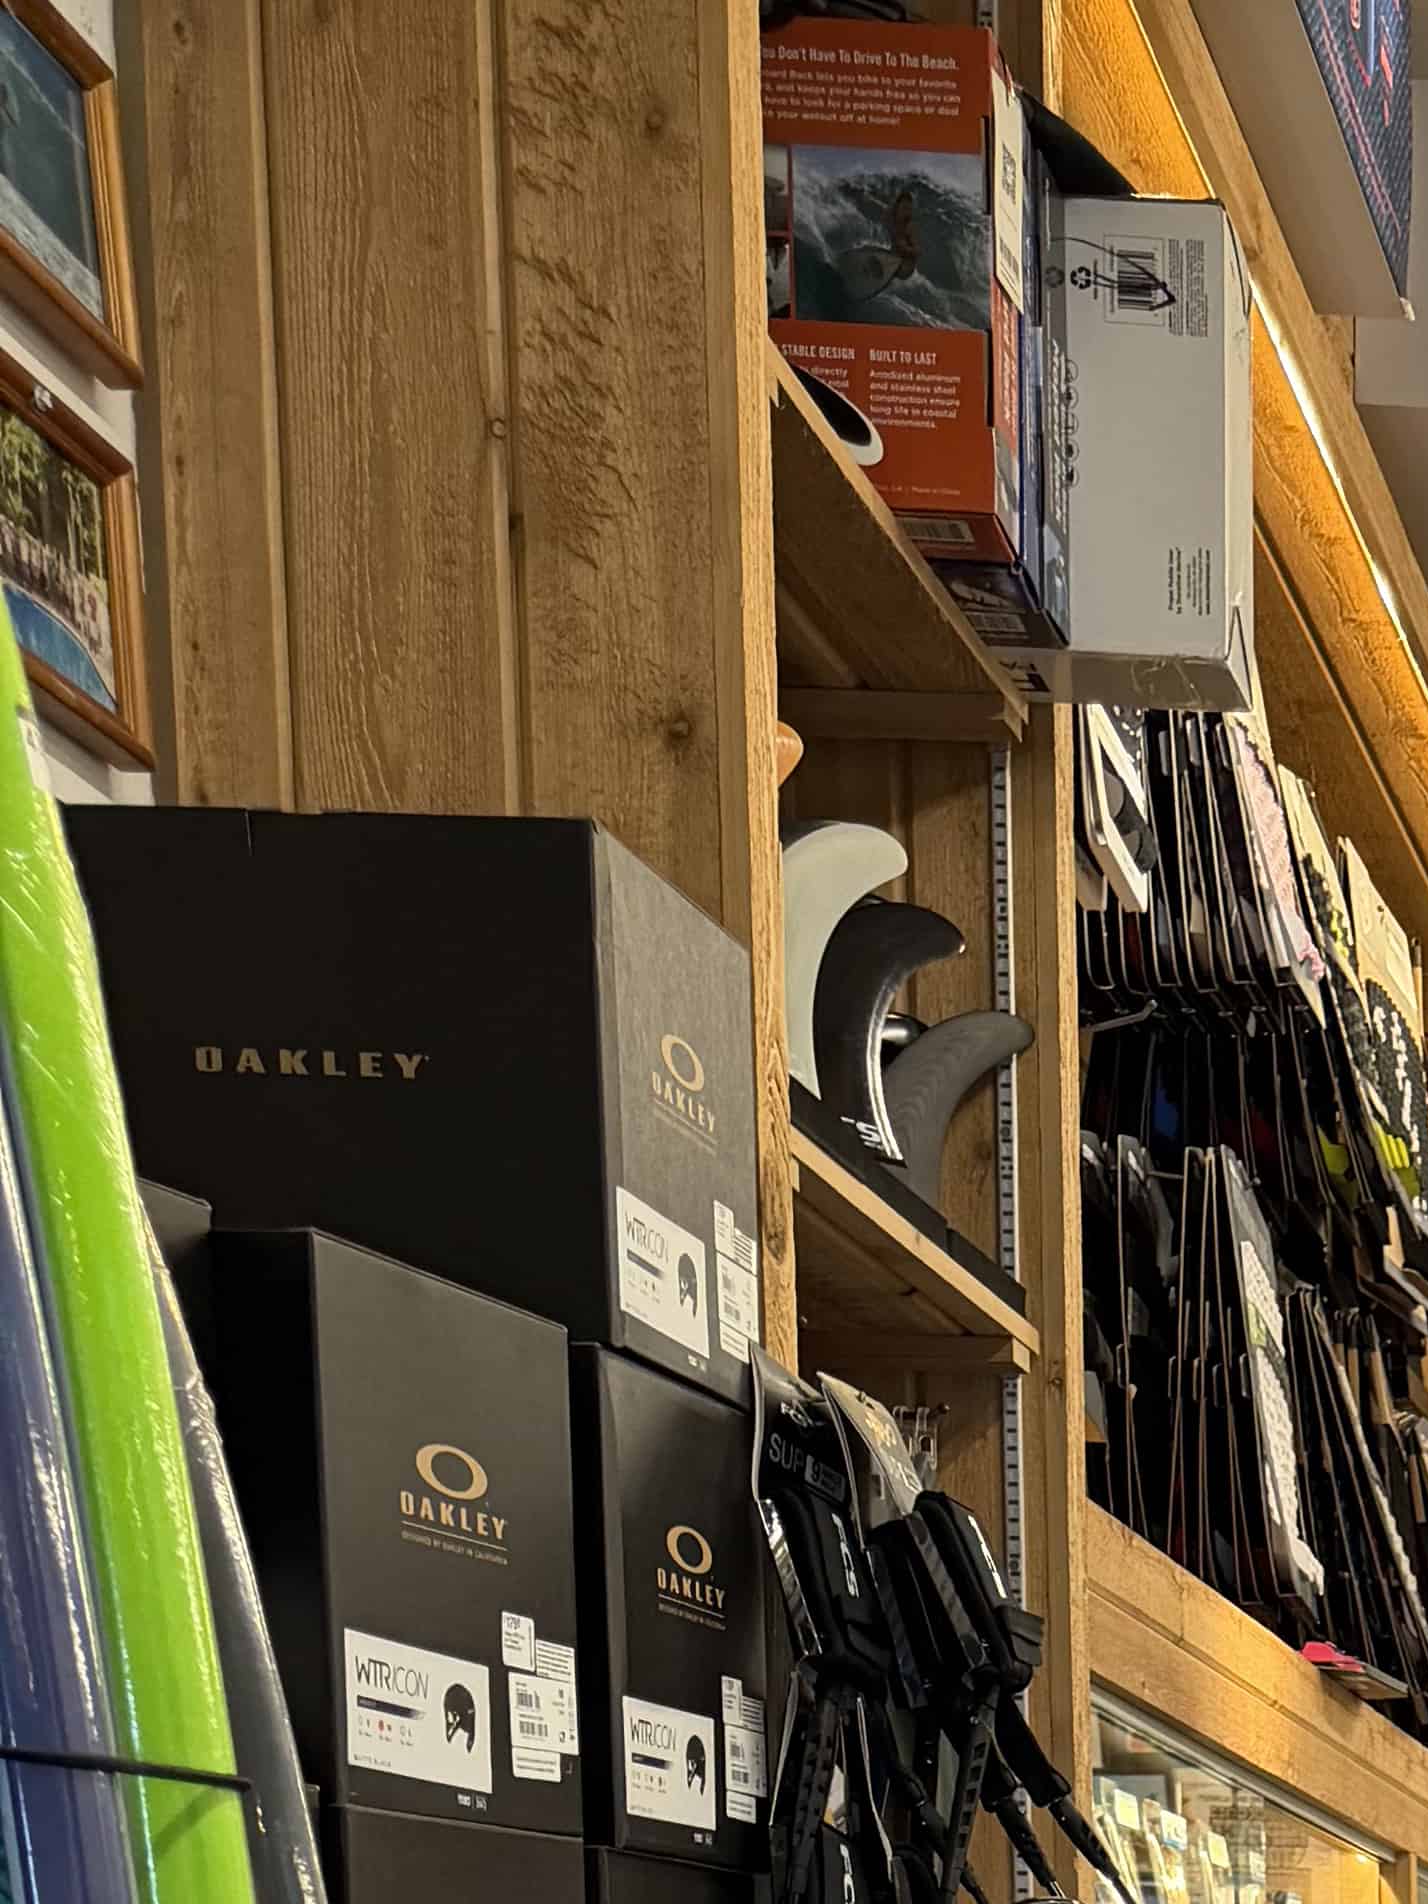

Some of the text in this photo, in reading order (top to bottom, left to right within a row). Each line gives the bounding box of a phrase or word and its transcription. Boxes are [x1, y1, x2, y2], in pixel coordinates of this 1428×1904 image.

[778, 45, 807, 62] Don't
[809, 48, 836, 62] Have
[839, 49, 851, 64] To
[853, 50, 883, 66] Drive
[884, 51, 897, 67] To
[900, 52, 920, 69] The
[921, 54, 960, 71] Beach.
[781, 343, 856, 361] STABLE DESIGN
[869, 349, 937, 366] BUILT TO LAST
[195, 1046, 428, 1080] OAKLEY
[651, 1071, 716, 1134] OAKLEY
[400, 1490, 507, 1540] OAKLEY
[656, 1566, 726, 1609] OAKLEY
